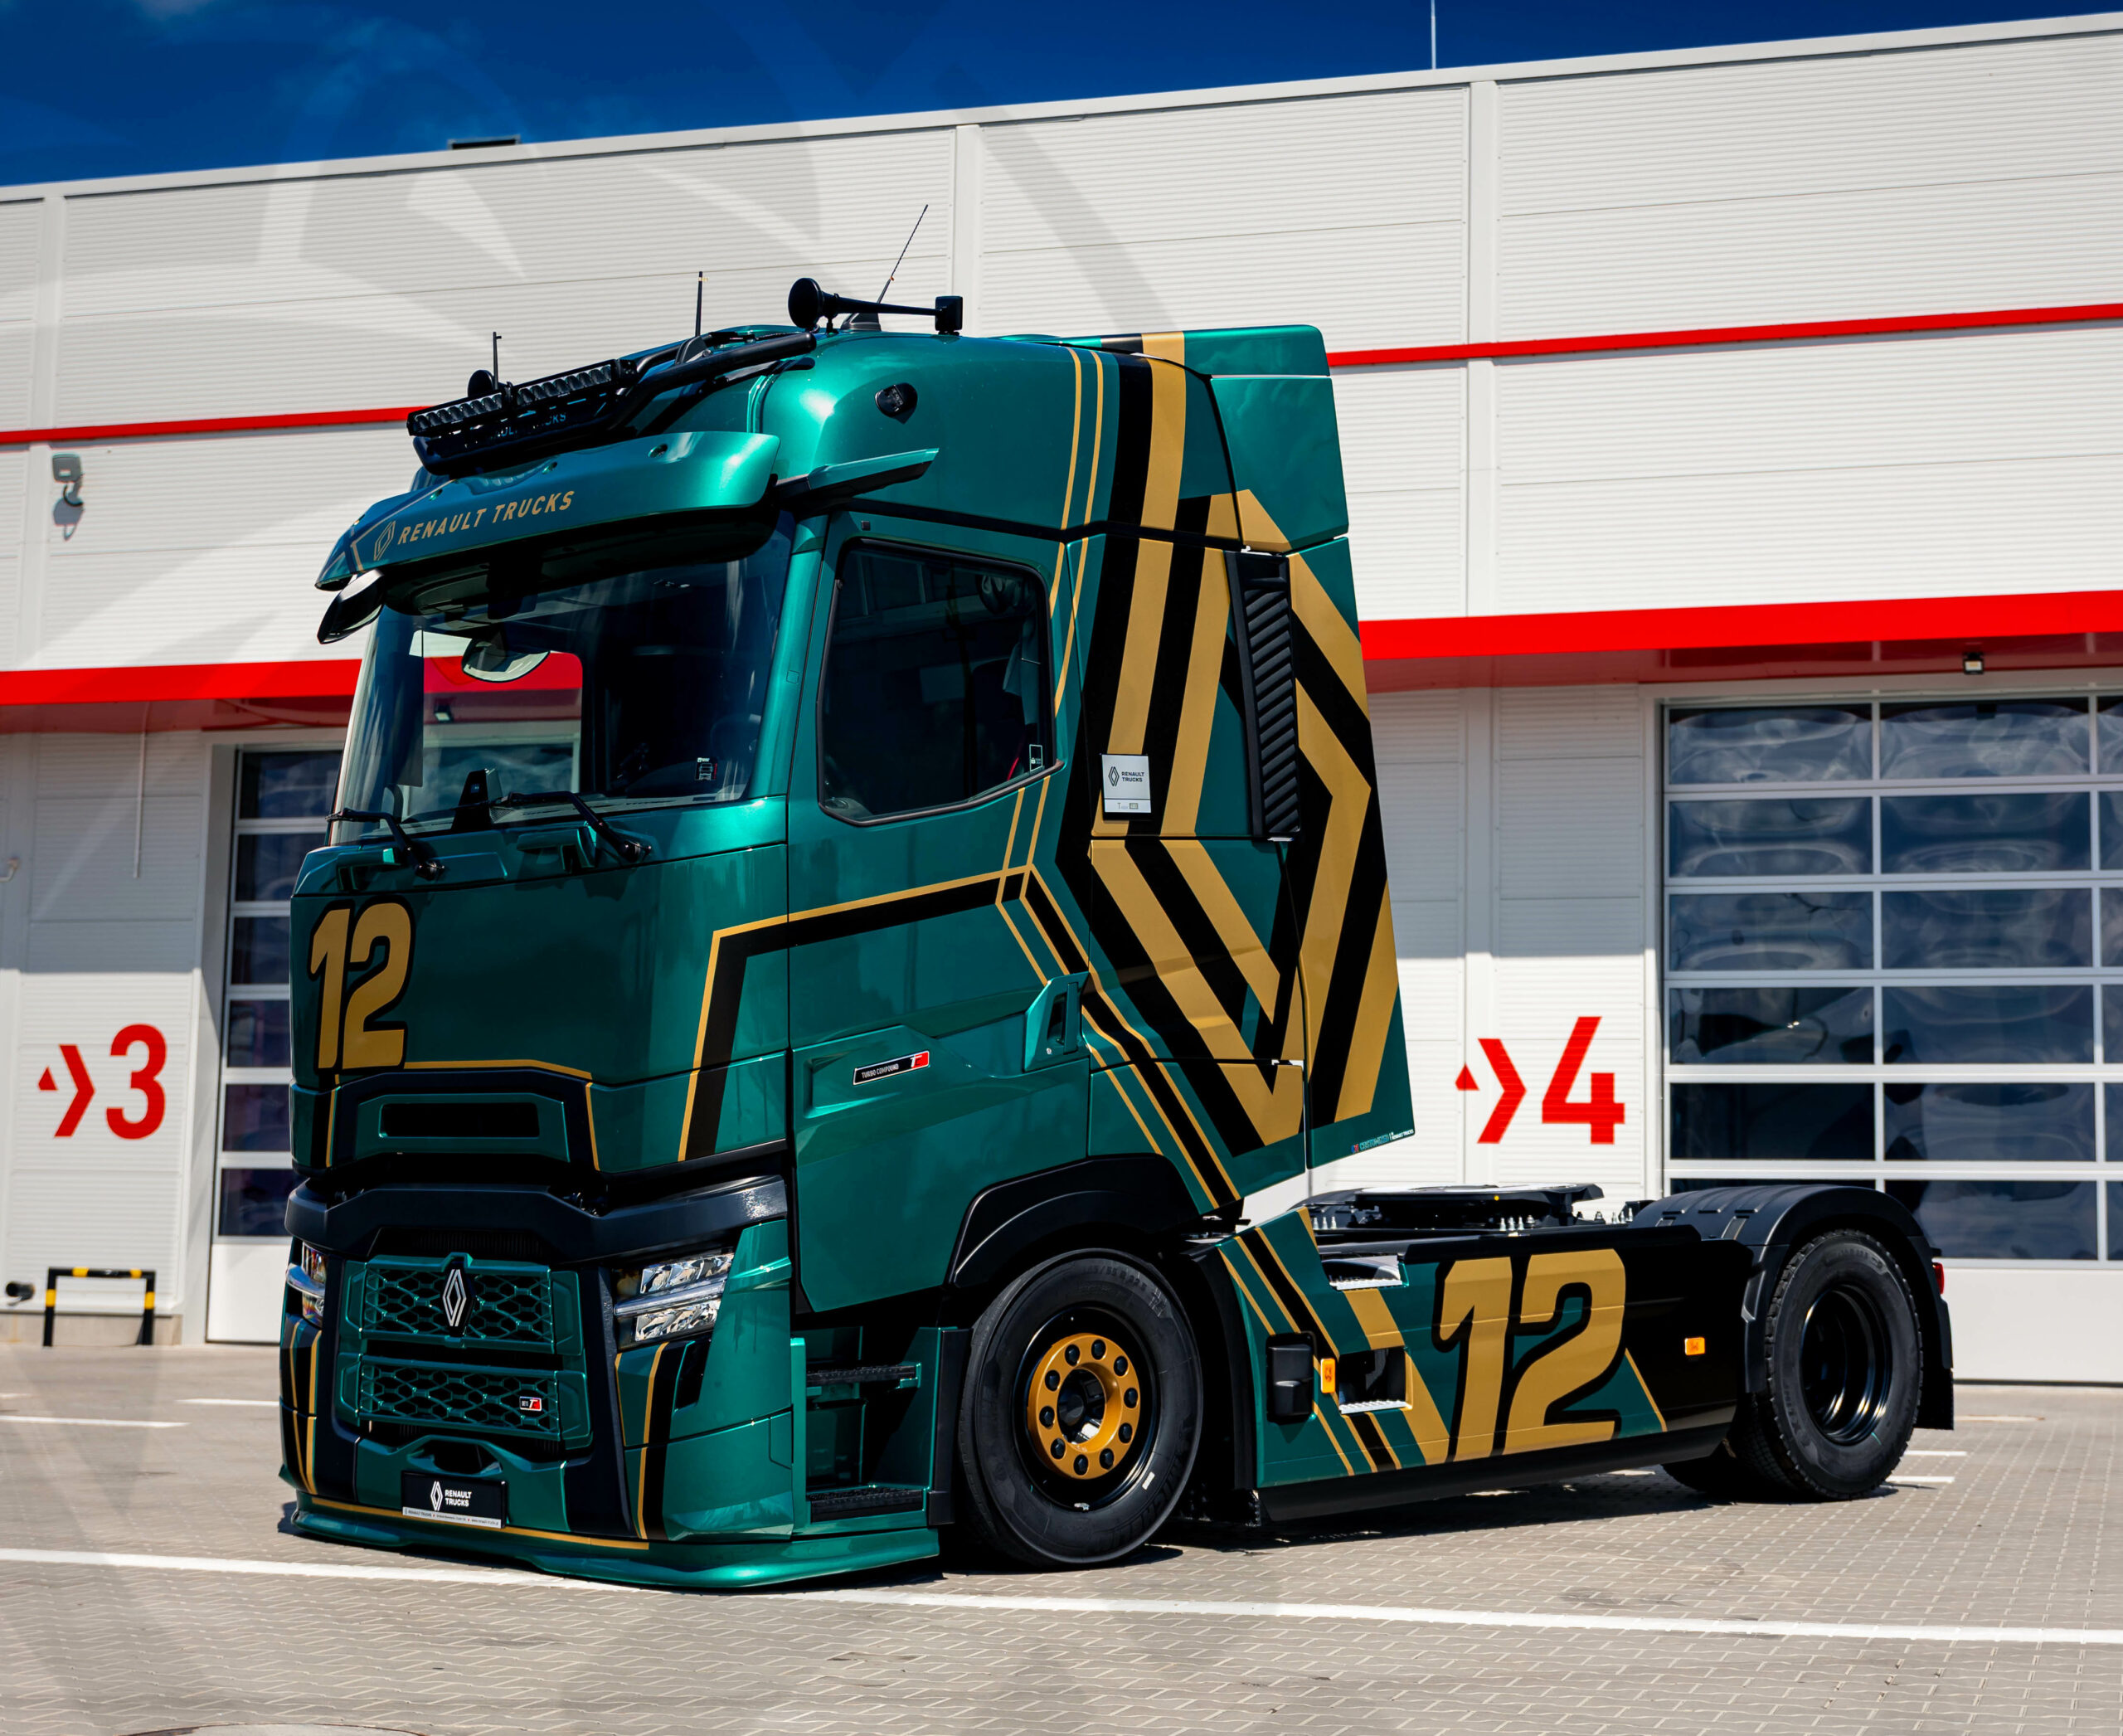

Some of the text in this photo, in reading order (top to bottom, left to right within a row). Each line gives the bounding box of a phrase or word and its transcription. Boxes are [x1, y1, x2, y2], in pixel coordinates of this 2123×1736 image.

[397, 490, 575, 545] RENAULT TRUCKS
[308, 901, 412, 1071] 12
[106, 1024, 168, 1140] 3
[862, 1069, 876, 1078] TURBO
[876, 1063, 899, 1075] COMPOUND
[1542, 1016, 1625, 1145] 4
[1440, 1248, 1626, 1463] 12
[445, 1489, 472, 1500] RENAULT
[445, 1497, 469, 1507] TRUCKS
